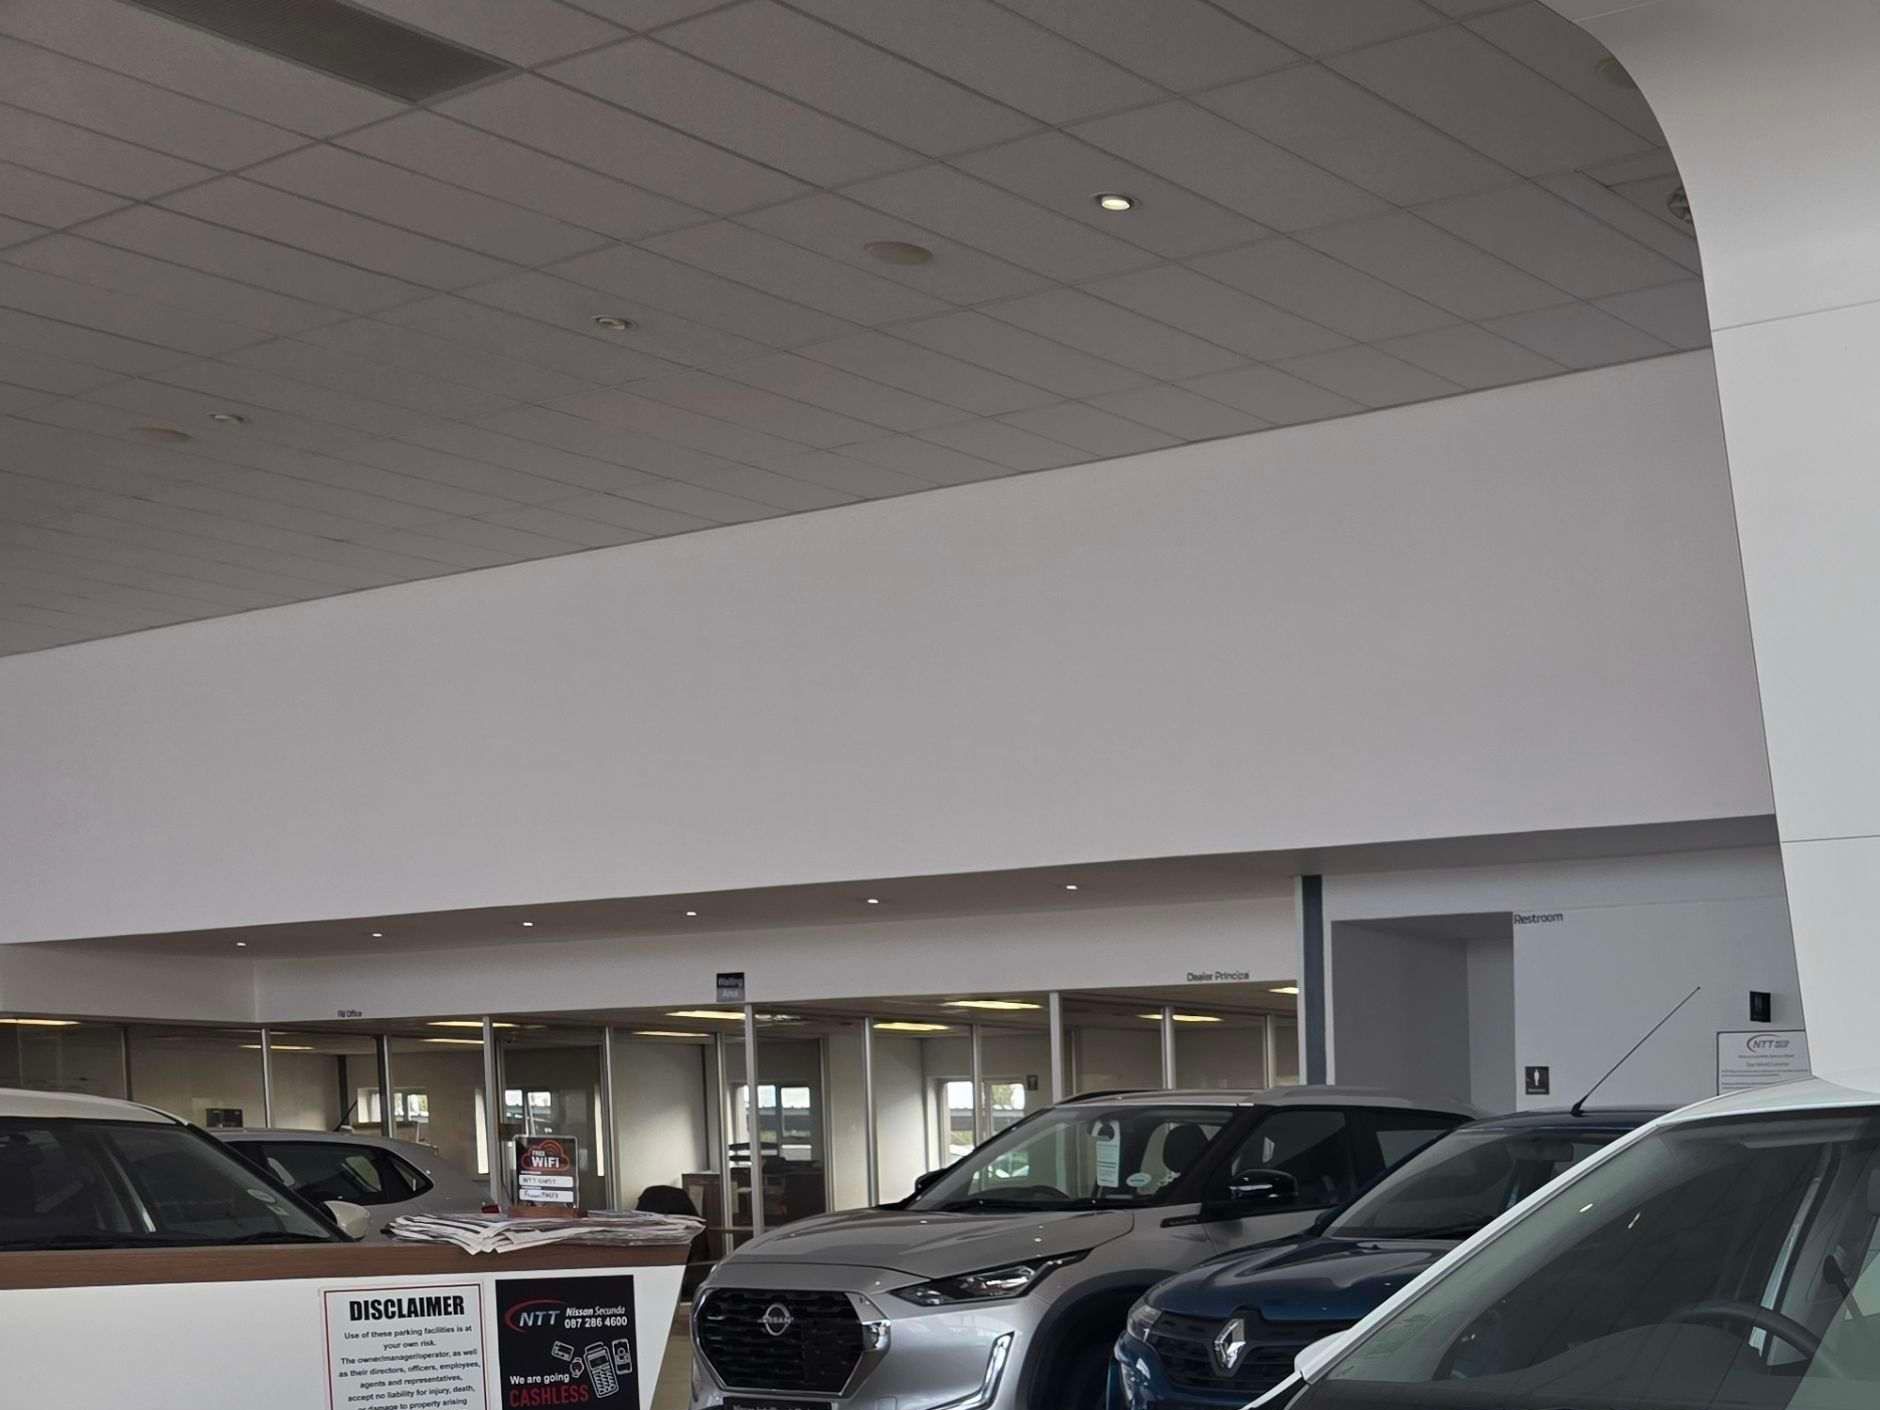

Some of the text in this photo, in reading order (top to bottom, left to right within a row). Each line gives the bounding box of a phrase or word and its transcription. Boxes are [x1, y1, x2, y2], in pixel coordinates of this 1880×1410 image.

[1514, 913, 1563, 924] Restroom
[349, 1295, 465, 1321] DISCLAIMER
[519, 1305, 626, 1327] NTT Nissan Secunda
[564, 1316, 628, 1328] 087 286 4600
[344, 1331, 359, 1340] Use
[371, 1330, 393, 1338] these
[394, 1327, 422, 1337] parking
[424, 1326, 455, 1335] facilities
[457, 1325, 463, 1333] is
[383, 1343, 401, 1351] your
[341, 1357, 355, 1365] The
[463, 1348, 478, 1356] well
[350, 1368, 368, 1377] their
[440, 1361, 481, 1371] employees,
[360, 1380, 386, 1389] agents
[510, 1372, 570, 1385] We are going
[348, 1393, 374, 1402] accept
[387, 1390, 414, 1399] liability
[416, 1388, 427, 1396] for
[509, 1385, 589, 1408] CASHLESS
[400, 1402, 408, 1410] to
[409, 1401, 441, 1410] property
[443, 1398, 467, 1406] arising
